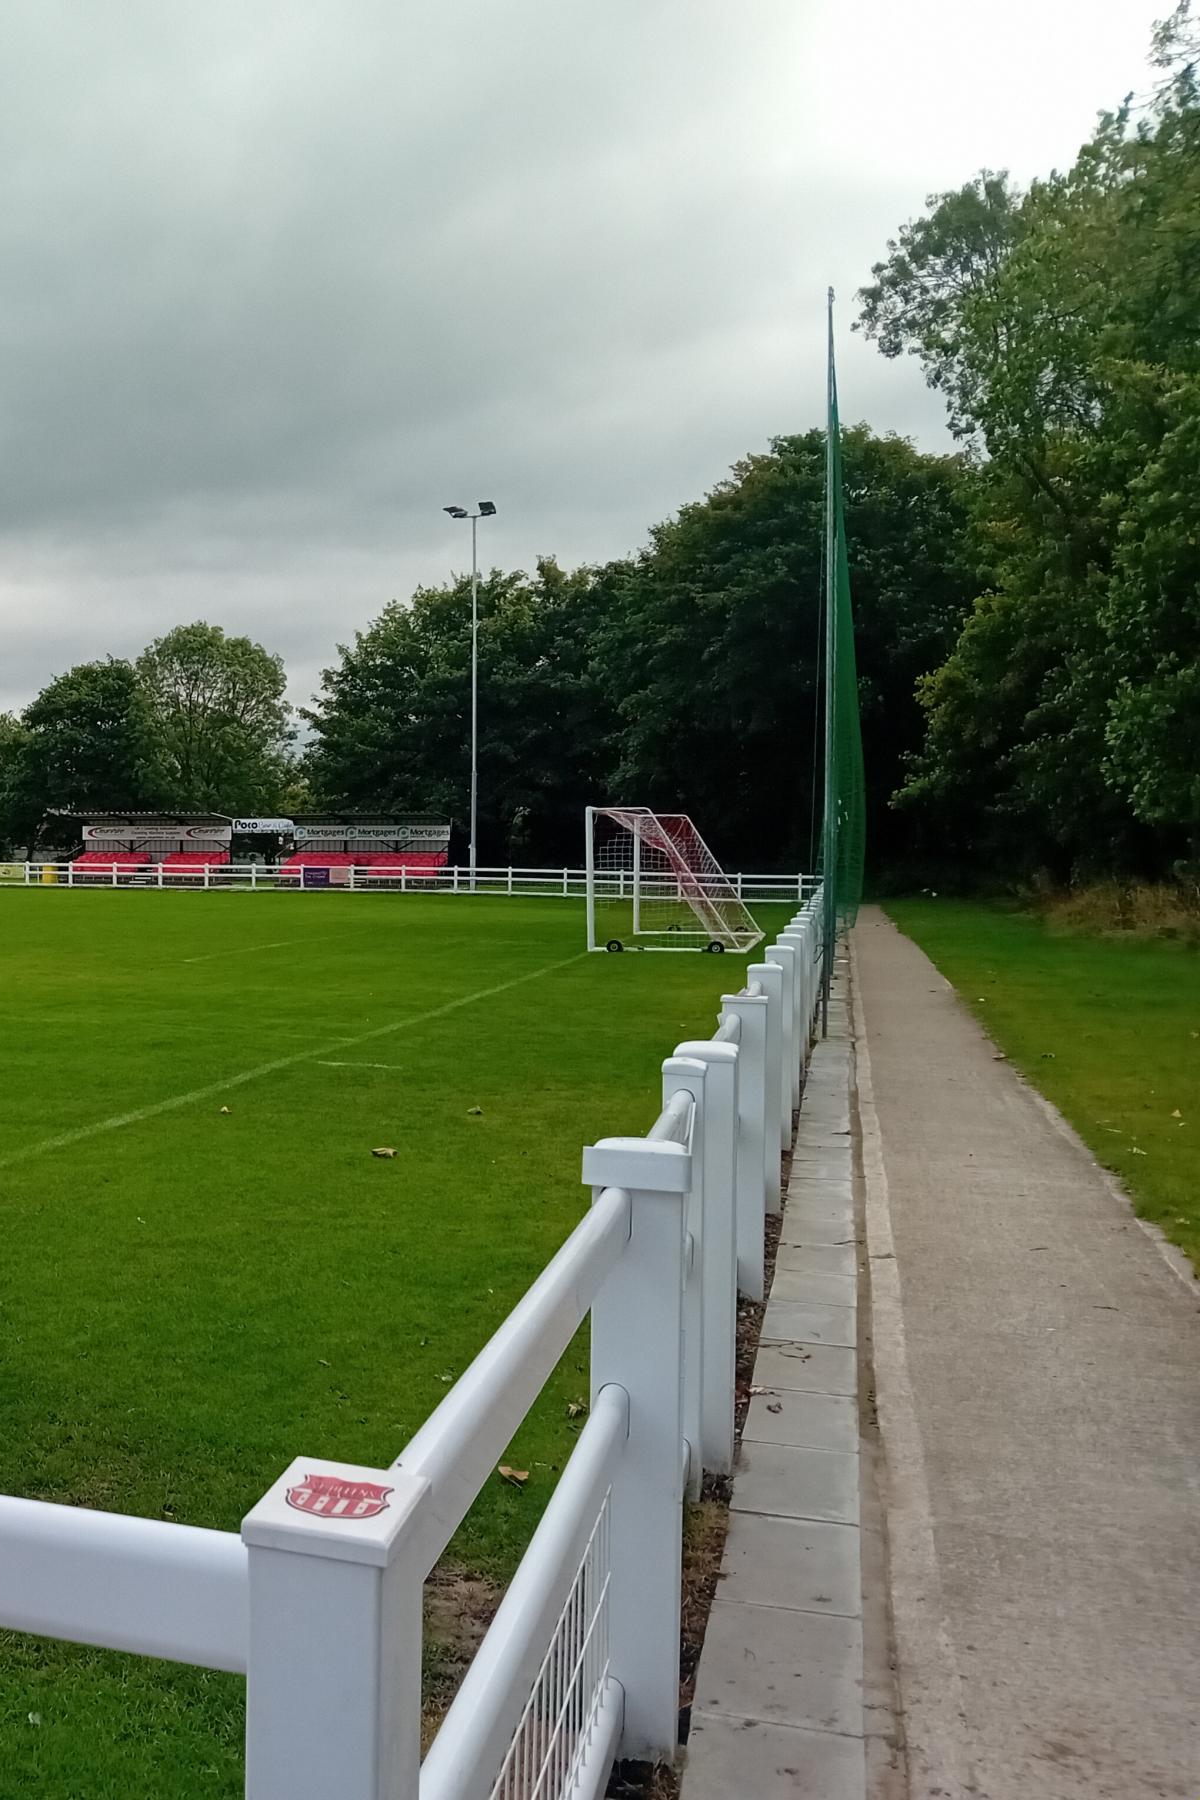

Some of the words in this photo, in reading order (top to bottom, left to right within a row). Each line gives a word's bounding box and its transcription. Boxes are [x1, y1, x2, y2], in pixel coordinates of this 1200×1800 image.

[234, 820, 258, 829] Poco
[307, 828, 344, 838] Mortgages
[358, 828, 396, 838] Mortgages
[410, 828, 449, 838] Mortgages
